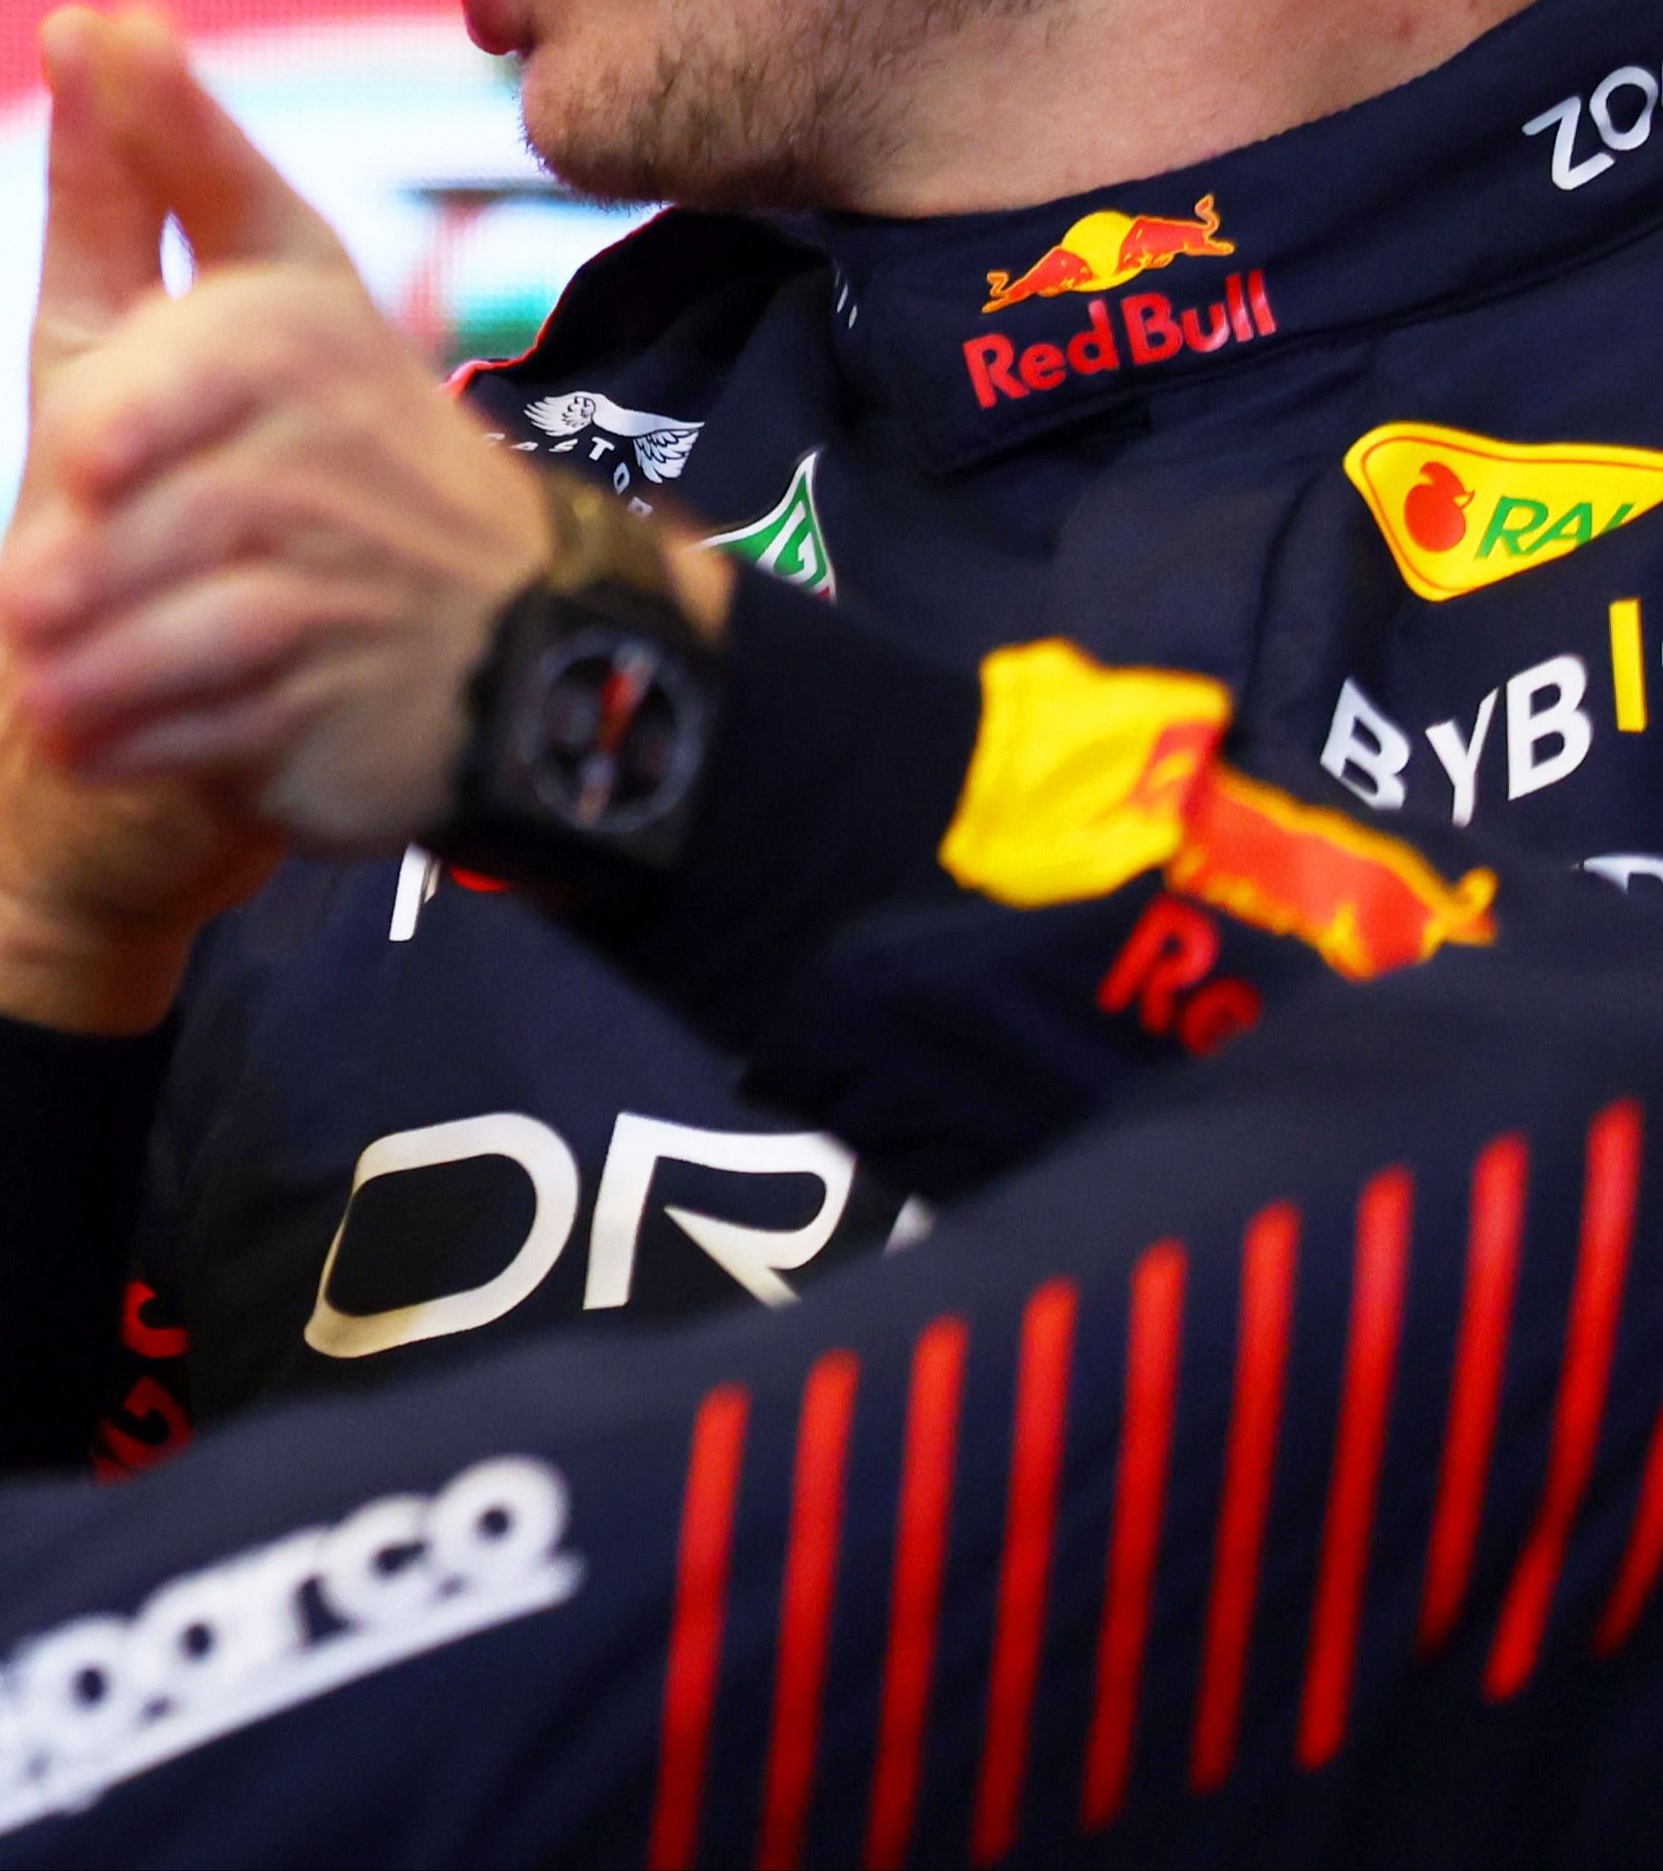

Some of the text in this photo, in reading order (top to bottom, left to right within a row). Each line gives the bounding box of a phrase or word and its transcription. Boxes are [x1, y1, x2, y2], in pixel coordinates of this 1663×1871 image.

[1522, 65, 1663, 192] zo
[962, 299, 1121, 409] Red
[1121, 269, 1278, 366] Bull
[1320, 597, 1663, 828] BYBI
